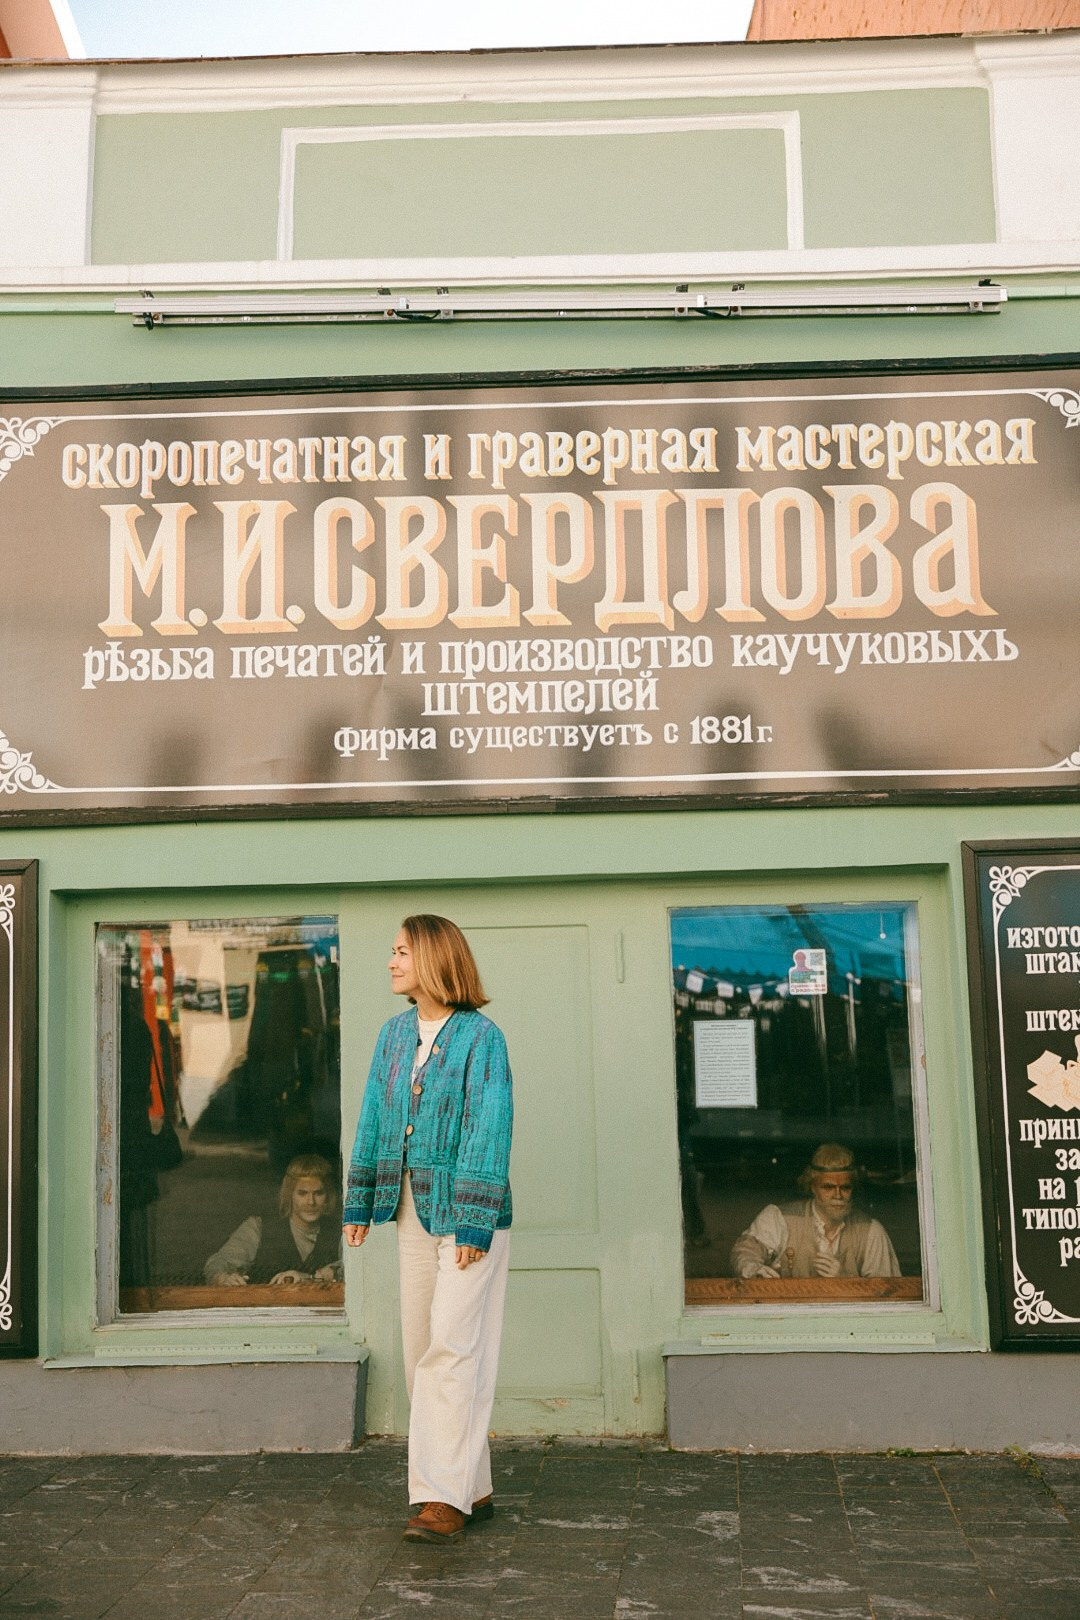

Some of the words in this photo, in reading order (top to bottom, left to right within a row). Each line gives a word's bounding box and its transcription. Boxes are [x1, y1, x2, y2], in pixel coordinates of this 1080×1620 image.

[62, 435, 407, 499] скоропечатная
[423, 433, 452, 480] и
[467, 428, 719, 486] граверная
[735, 417, 1038, 480] мастерская
[229, 635, 387, 679] печатей
[401, 641, 425, 675] и
[438, 635, 713, 679] производство
[421, 671, 659, 717] штемпелей
[663, 722, 680, 744] с
[1037, 1177, 1066, 1200] на
[1022, 1207, 1080, 1230] типо
